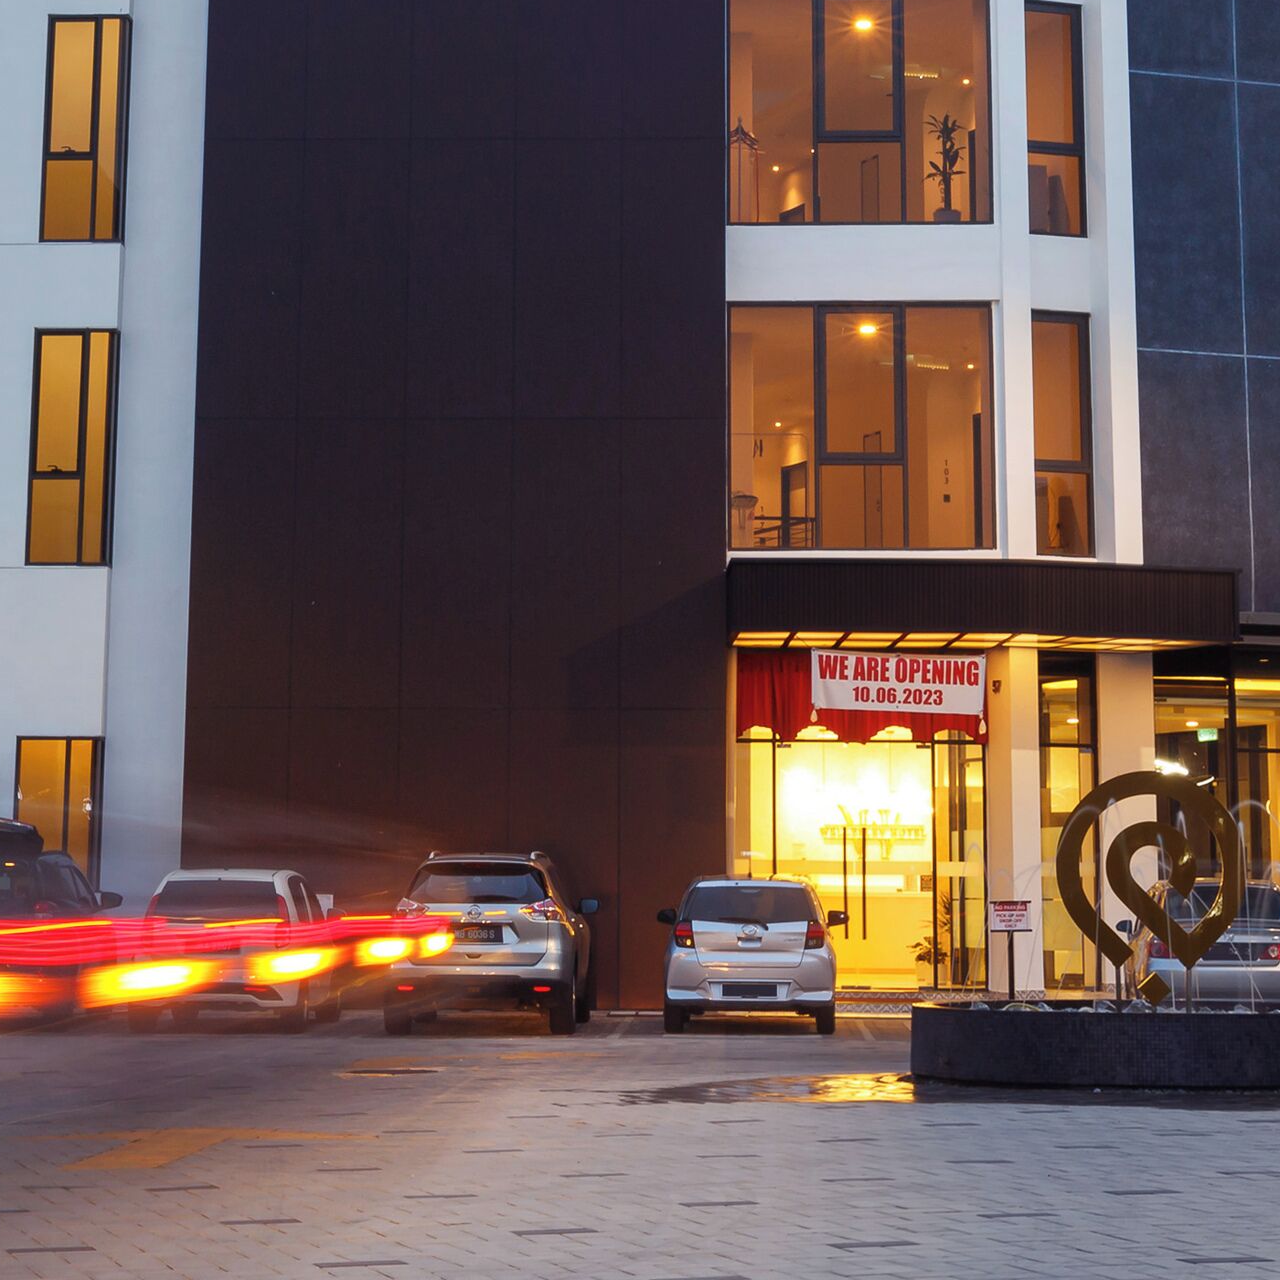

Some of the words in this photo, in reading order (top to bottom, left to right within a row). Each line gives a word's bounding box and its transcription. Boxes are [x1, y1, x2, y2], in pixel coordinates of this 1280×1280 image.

[818, 654, 848, 680] WE
[853, 656, 890, 682] ARE
[894, 658, 979, 686] OPENING
[852, 686, 943, 705] 10.06.2023
